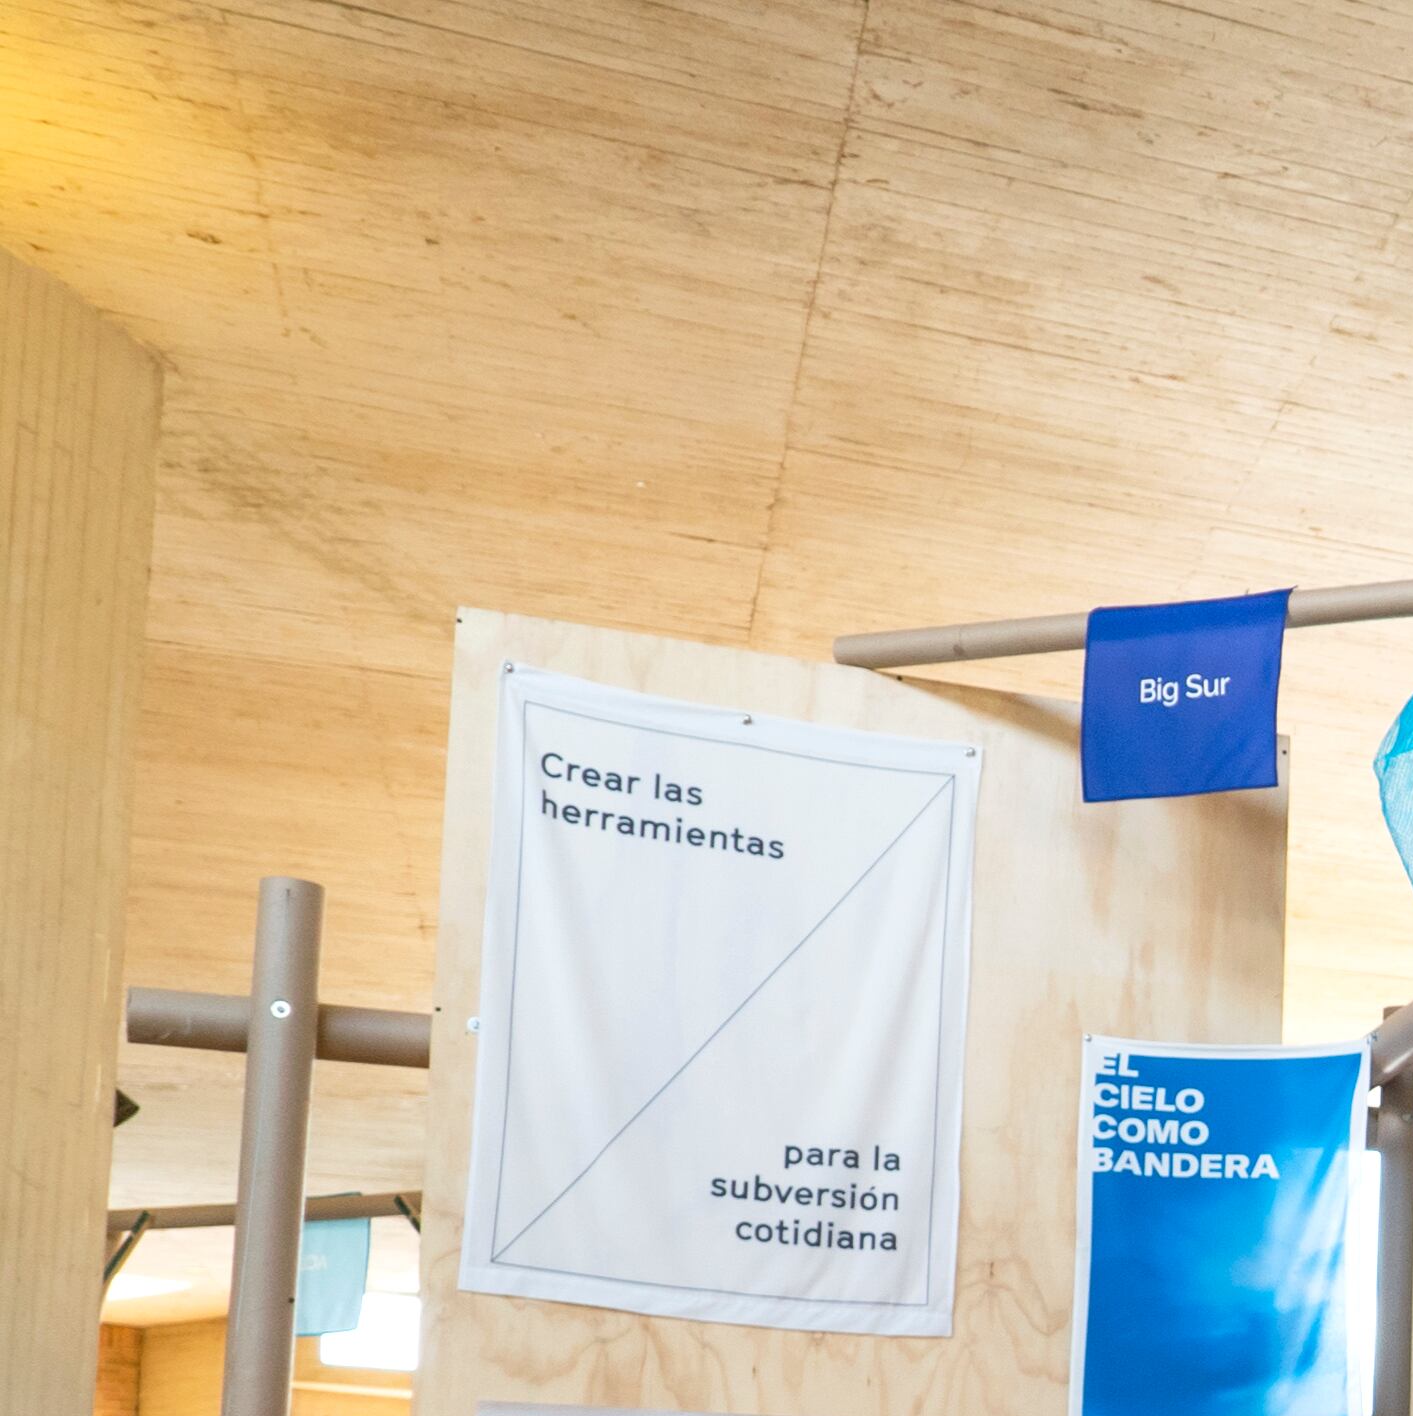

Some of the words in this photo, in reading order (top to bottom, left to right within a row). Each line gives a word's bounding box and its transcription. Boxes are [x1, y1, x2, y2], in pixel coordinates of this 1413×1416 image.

[1139, 675, 1180, 708] Big
[1185, 672, 1230, 700] Sur
[540, 752, 639, 796] Crear
[653, 762, 703, 806] las
[540, 792, 785, 861] herramientas
[1097, 1053, 1139, 1078] EL
[1094, 1082, 1205, 1114] CIELO
[1093, 1114, 1209, 1146] COMO
[783, 1143, 859, 1174] para
[874, 1144, 901, 1172] la
[1092, 1147, 1280, 1179] BANDERA
[710, 1173, 899, 1213] subversión
[735, 1215, 898, 1253] cotidiana
